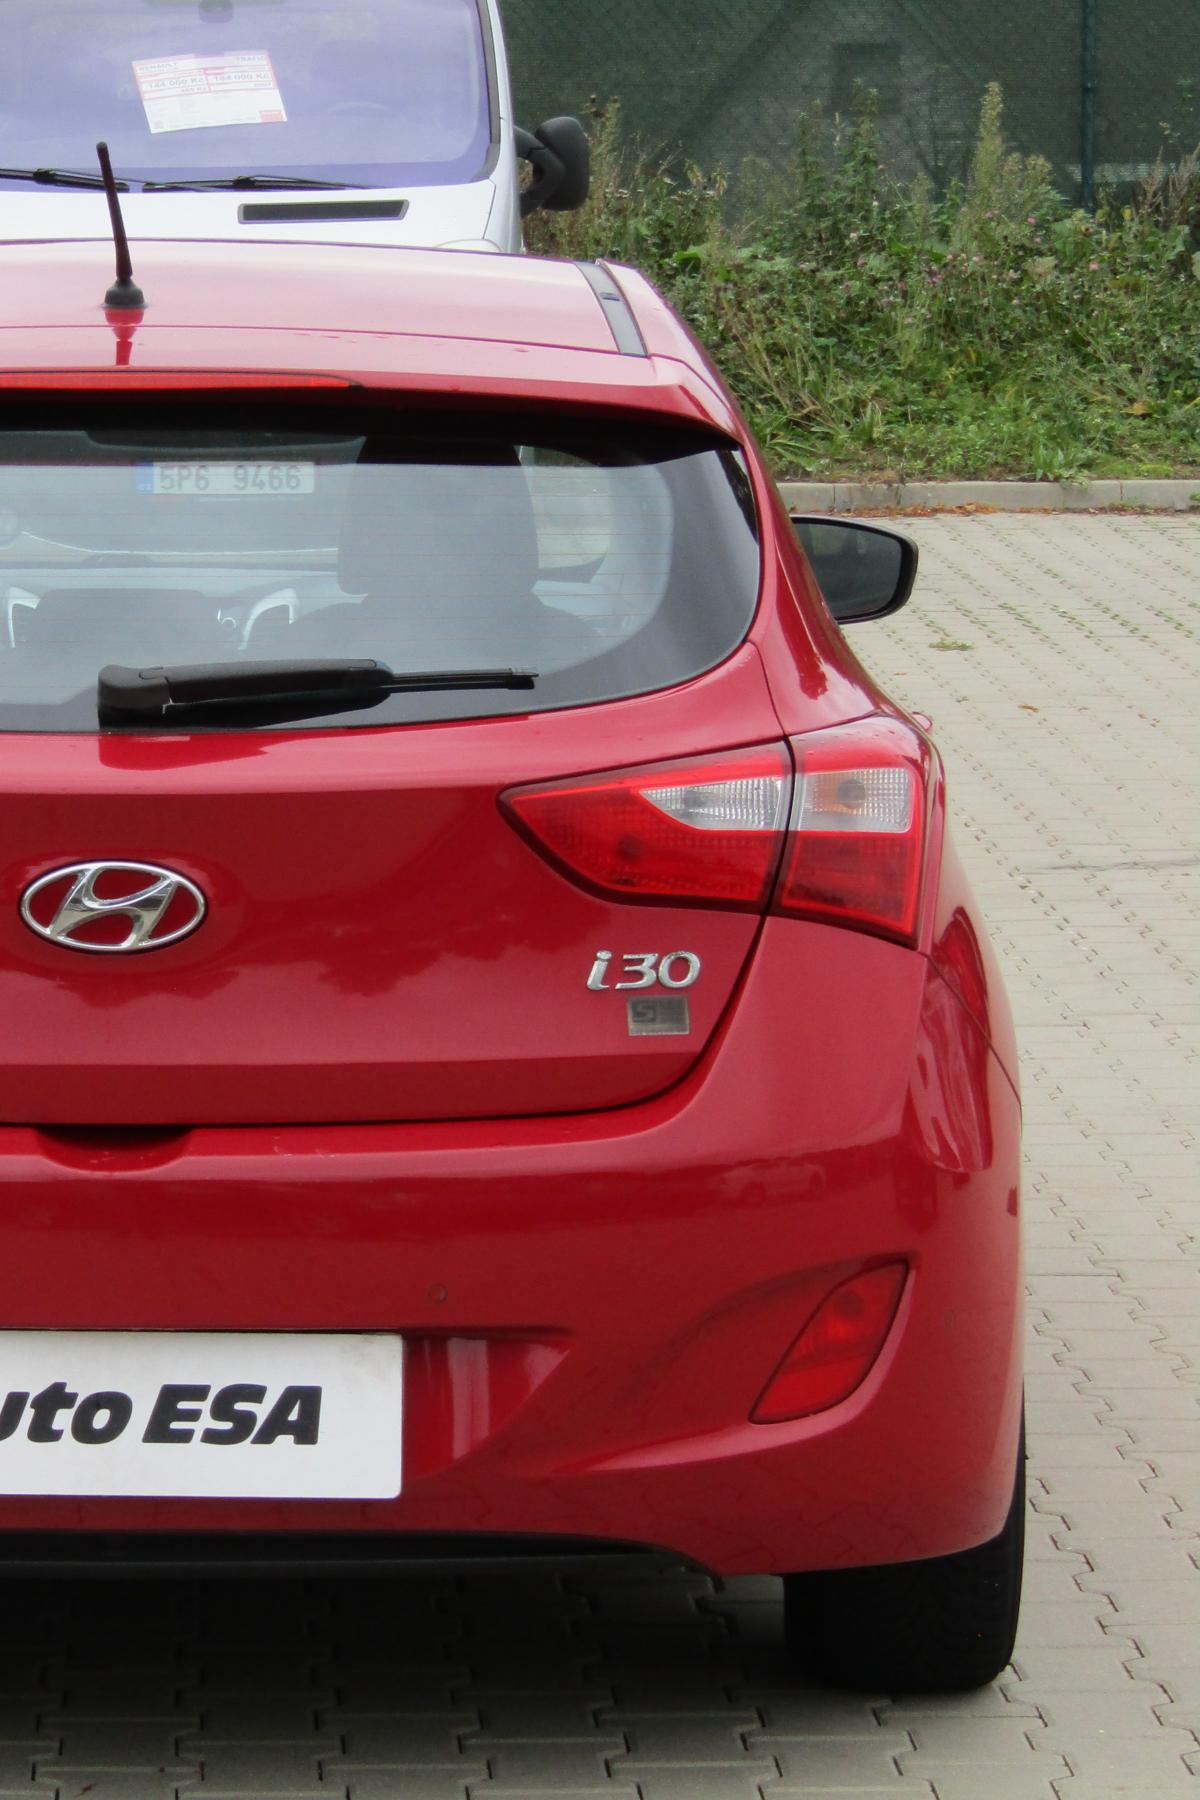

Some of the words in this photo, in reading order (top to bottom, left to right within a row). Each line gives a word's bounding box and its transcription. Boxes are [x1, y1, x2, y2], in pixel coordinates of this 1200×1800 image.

[160, 463, 210, 491] 5P6
[233, 463, 301, 491] 9466
[586, 950, 701, 990] i30
[142, 1383, 323, 1445] ESA
